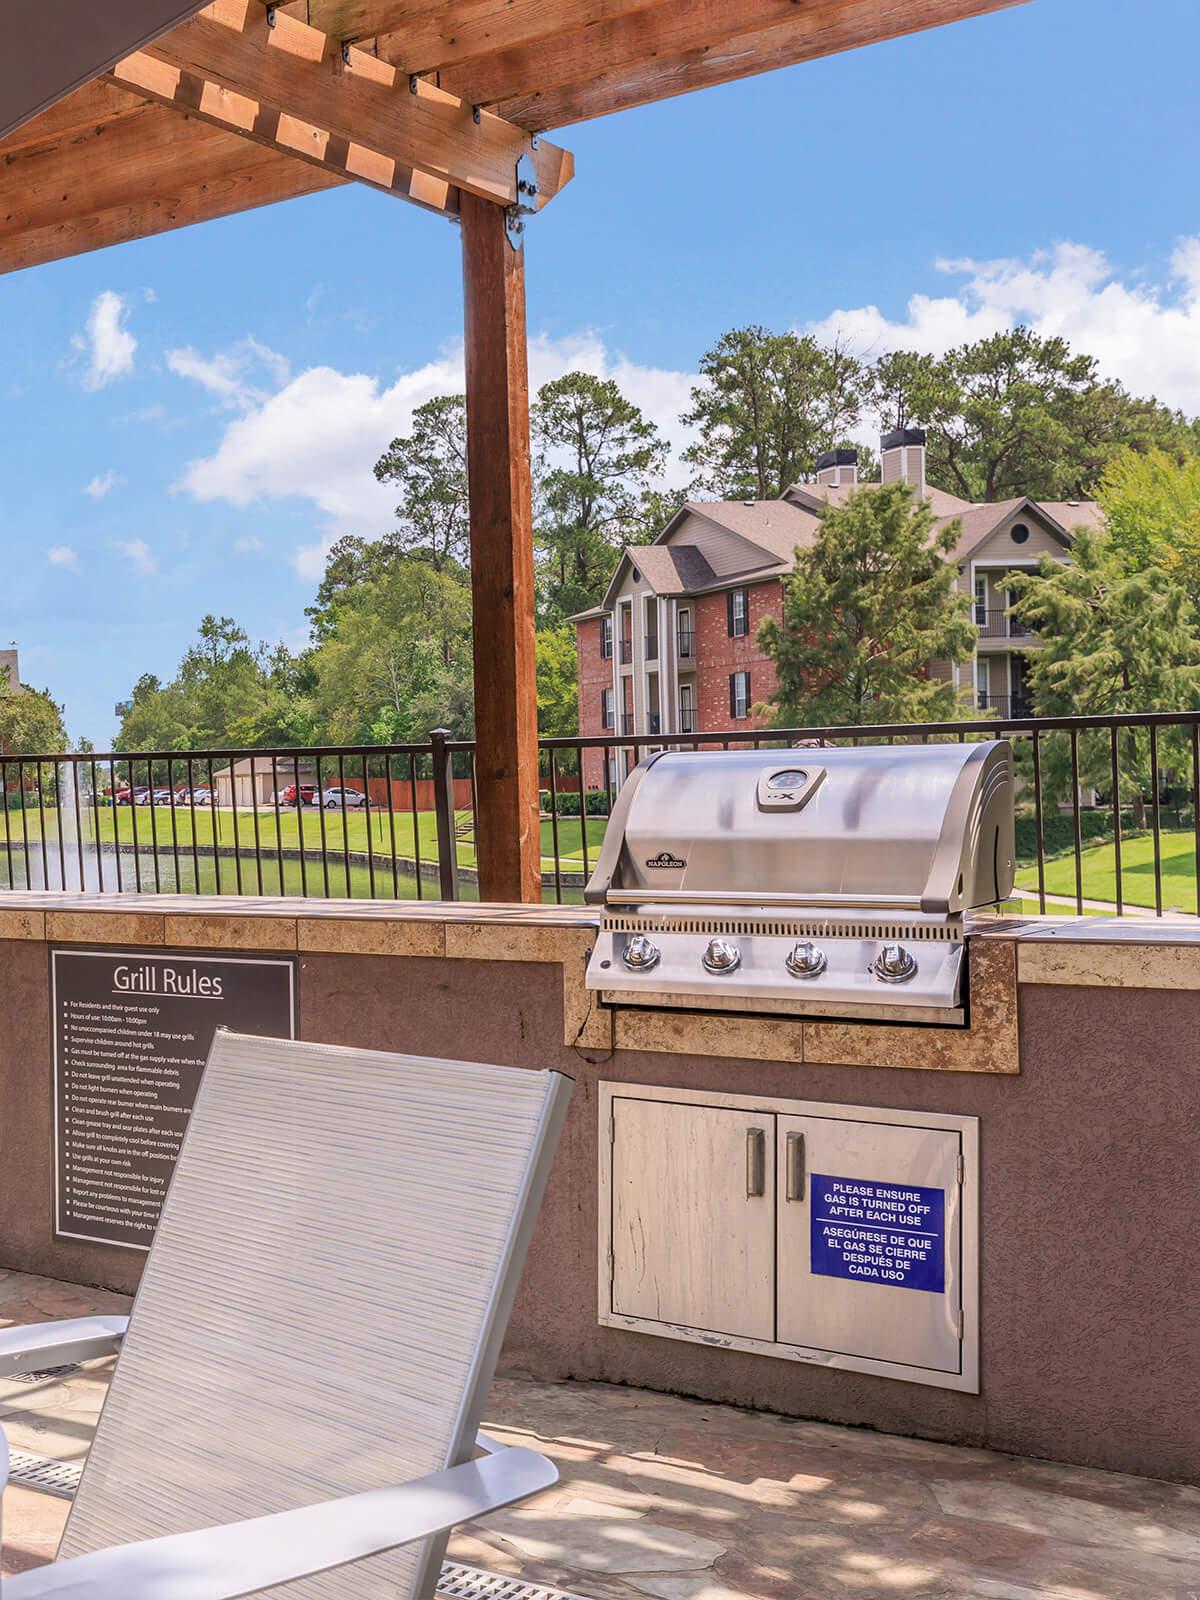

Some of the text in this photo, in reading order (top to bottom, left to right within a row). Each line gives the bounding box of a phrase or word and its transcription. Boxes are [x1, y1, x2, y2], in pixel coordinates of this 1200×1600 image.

[113, 965, 223, 996] Grill Rules
[70, 1000, 78, 1008] For
[79, 1001, 101, 1009] Residents
[112, 1003, 123, 1011] their
[148, 1006, 159, 1015] only
[70, 1012, 84, 1020] Hours
[117, 1028, 137, 1036] children
[154, 1030, 159, 1038] 18
[160, 1032, 171, 1040] may
[182, 1033, 194, 1041] grills
[95, 1038, 113, 1046] children
[115, 1040, 132, 1048] around
[142, 1042, 154, 1050] grills
[101, 1049, 116, 1058] turned
[131, 1052, 139, 1060] the
[140, 1054, 148, 1062] gas
[150, 1055, 166, 1064] supply
[181, 1057, 195, 1065] when
[196, 1058, 205, 1066] the
[71, 1058, 85, 1066] Check
[87, 1061, 115, 1071] surrounding
[163, 1068, 179, 1076] debris
[72, 1070, 78, 1078] Do
[88, 1072, 100, 1080] leave
[102, 1074, 110, 1082] grill
[111, 1075, 139, 1084] unattended
[141, 1078, 154, 1086] when
[155, 1080, 180, 1090] operating
[88, 1084, 99, 1093] light
[100, 1085, 118, 1094] burners
[119, 1087, 133, 1095] when
[134, 1090, 158, 1100] operating
[72, 1093, 79, 1101] Do
[118, 1099, 134, 1107] burner
[135, 1101, 149, 1109] when
[163, 1104, 182, 1113] burners
[72, 1105, 85, 1114] Clean
[96, 1108, 109, 1116] brush
[110, 1110, 119, 1118] grill
[120, 1111, 131, 1119] after
[86, 1131, 95, 1139] grill
[102, 1134, 128, 1144] completely
[141, 1138, 156, 1146] before
[157, 1141, 179, 1151] covering
[132, 1148, 140, 1156] the
[149, 1152, 169, 1160] position
[113, 1171, 141, 1181] responsible
[150, 1175, 164, 1186] injury
[73, 1187, 88, 1196] Report
[89, 1191, 97, 1199] any
[99, 1192, 121, 1201] problems
[114, 1183, 141, 1192] responsible
[150, 1187, 159, 1195] lost
[833, 1184, 920, 1202] PLEASE ENSURE
[73, 1199, 87, 1208] Please
[88, 1201, 94, 1209] be
[120, 1207, 130, 1215] with
[144, 1210, 155, 1219] time
[824, 1194, 930, 1215] GAS IS TURNED OFF
[829, 1206, 921, 1225] AFTER EACH USE
[125, 1219, 133, 1227] the
[134, 1221, 146, 1230] right
[823, 1227, 931, 1249] ASEGÚRESE DE QUE
[828, 1239, 926, 1260] EL GAS SE CIERRE
[843, 1252, 911, 1269] DESPUÉS DE
[849, 1265, 904, 1281] CADA USO
